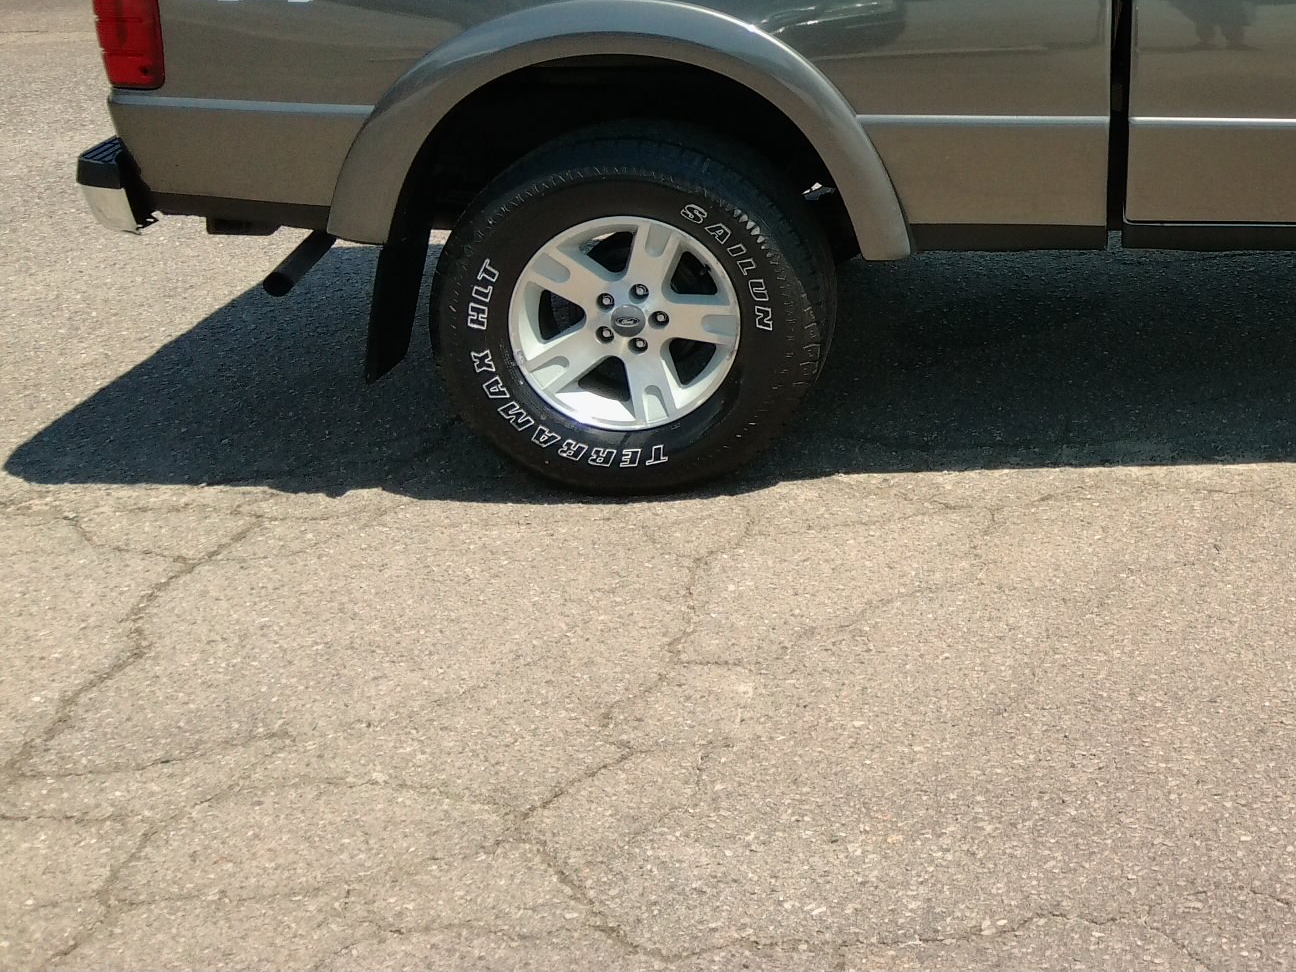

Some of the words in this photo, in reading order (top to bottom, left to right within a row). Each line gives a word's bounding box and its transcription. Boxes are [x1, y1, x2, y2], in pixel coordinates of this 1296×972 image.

[467, 258, 500, 330] HLT
[680, 203, 773, 331] SAILUN
[470, 349, 669, 468] TERRAMAX
